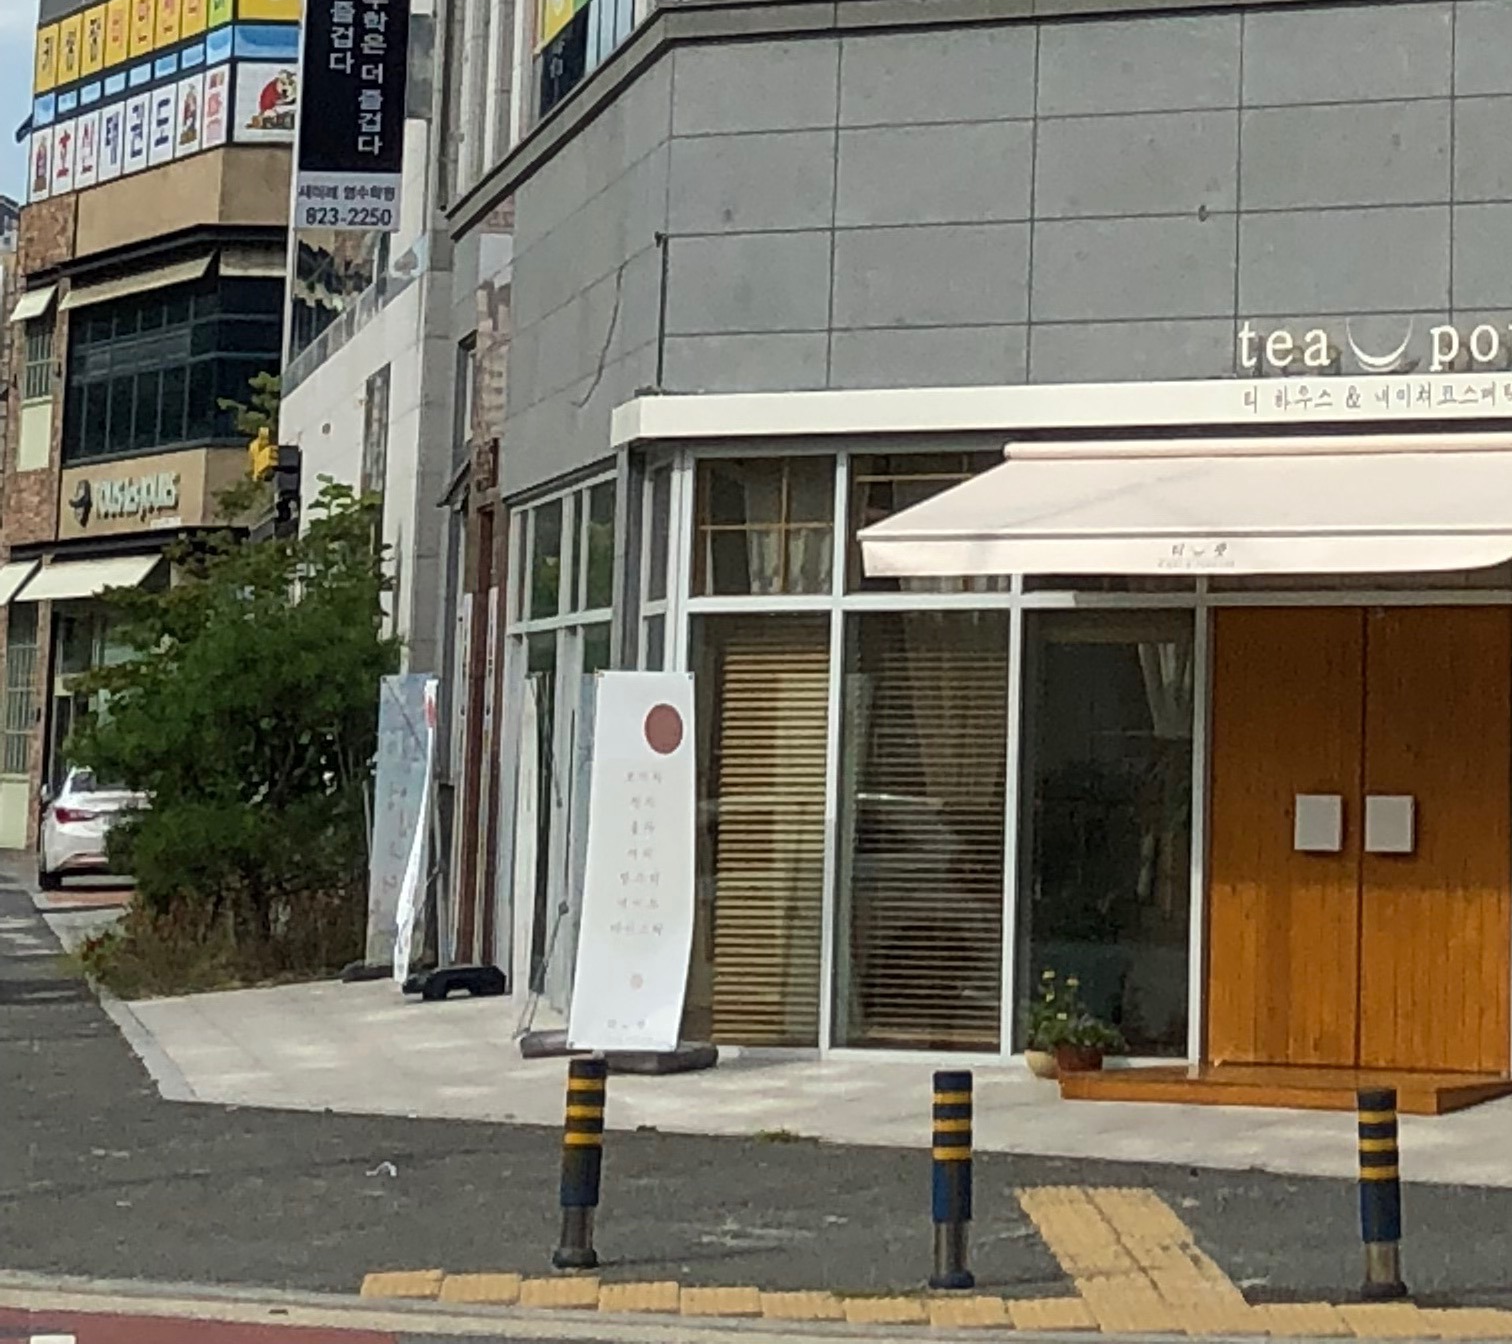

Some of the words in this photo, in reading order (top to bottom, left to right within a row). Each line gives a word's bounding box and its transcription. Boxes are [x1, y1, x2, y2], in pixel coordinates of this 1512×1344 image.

[361, 62, 384, 85] 더
[306, 207, 392, 226] 823-2250
[1238, 320, 1332, 369] tea
[1273, 384, 1333, 411] 하우스
[1346, 384, 1361, 409] &
